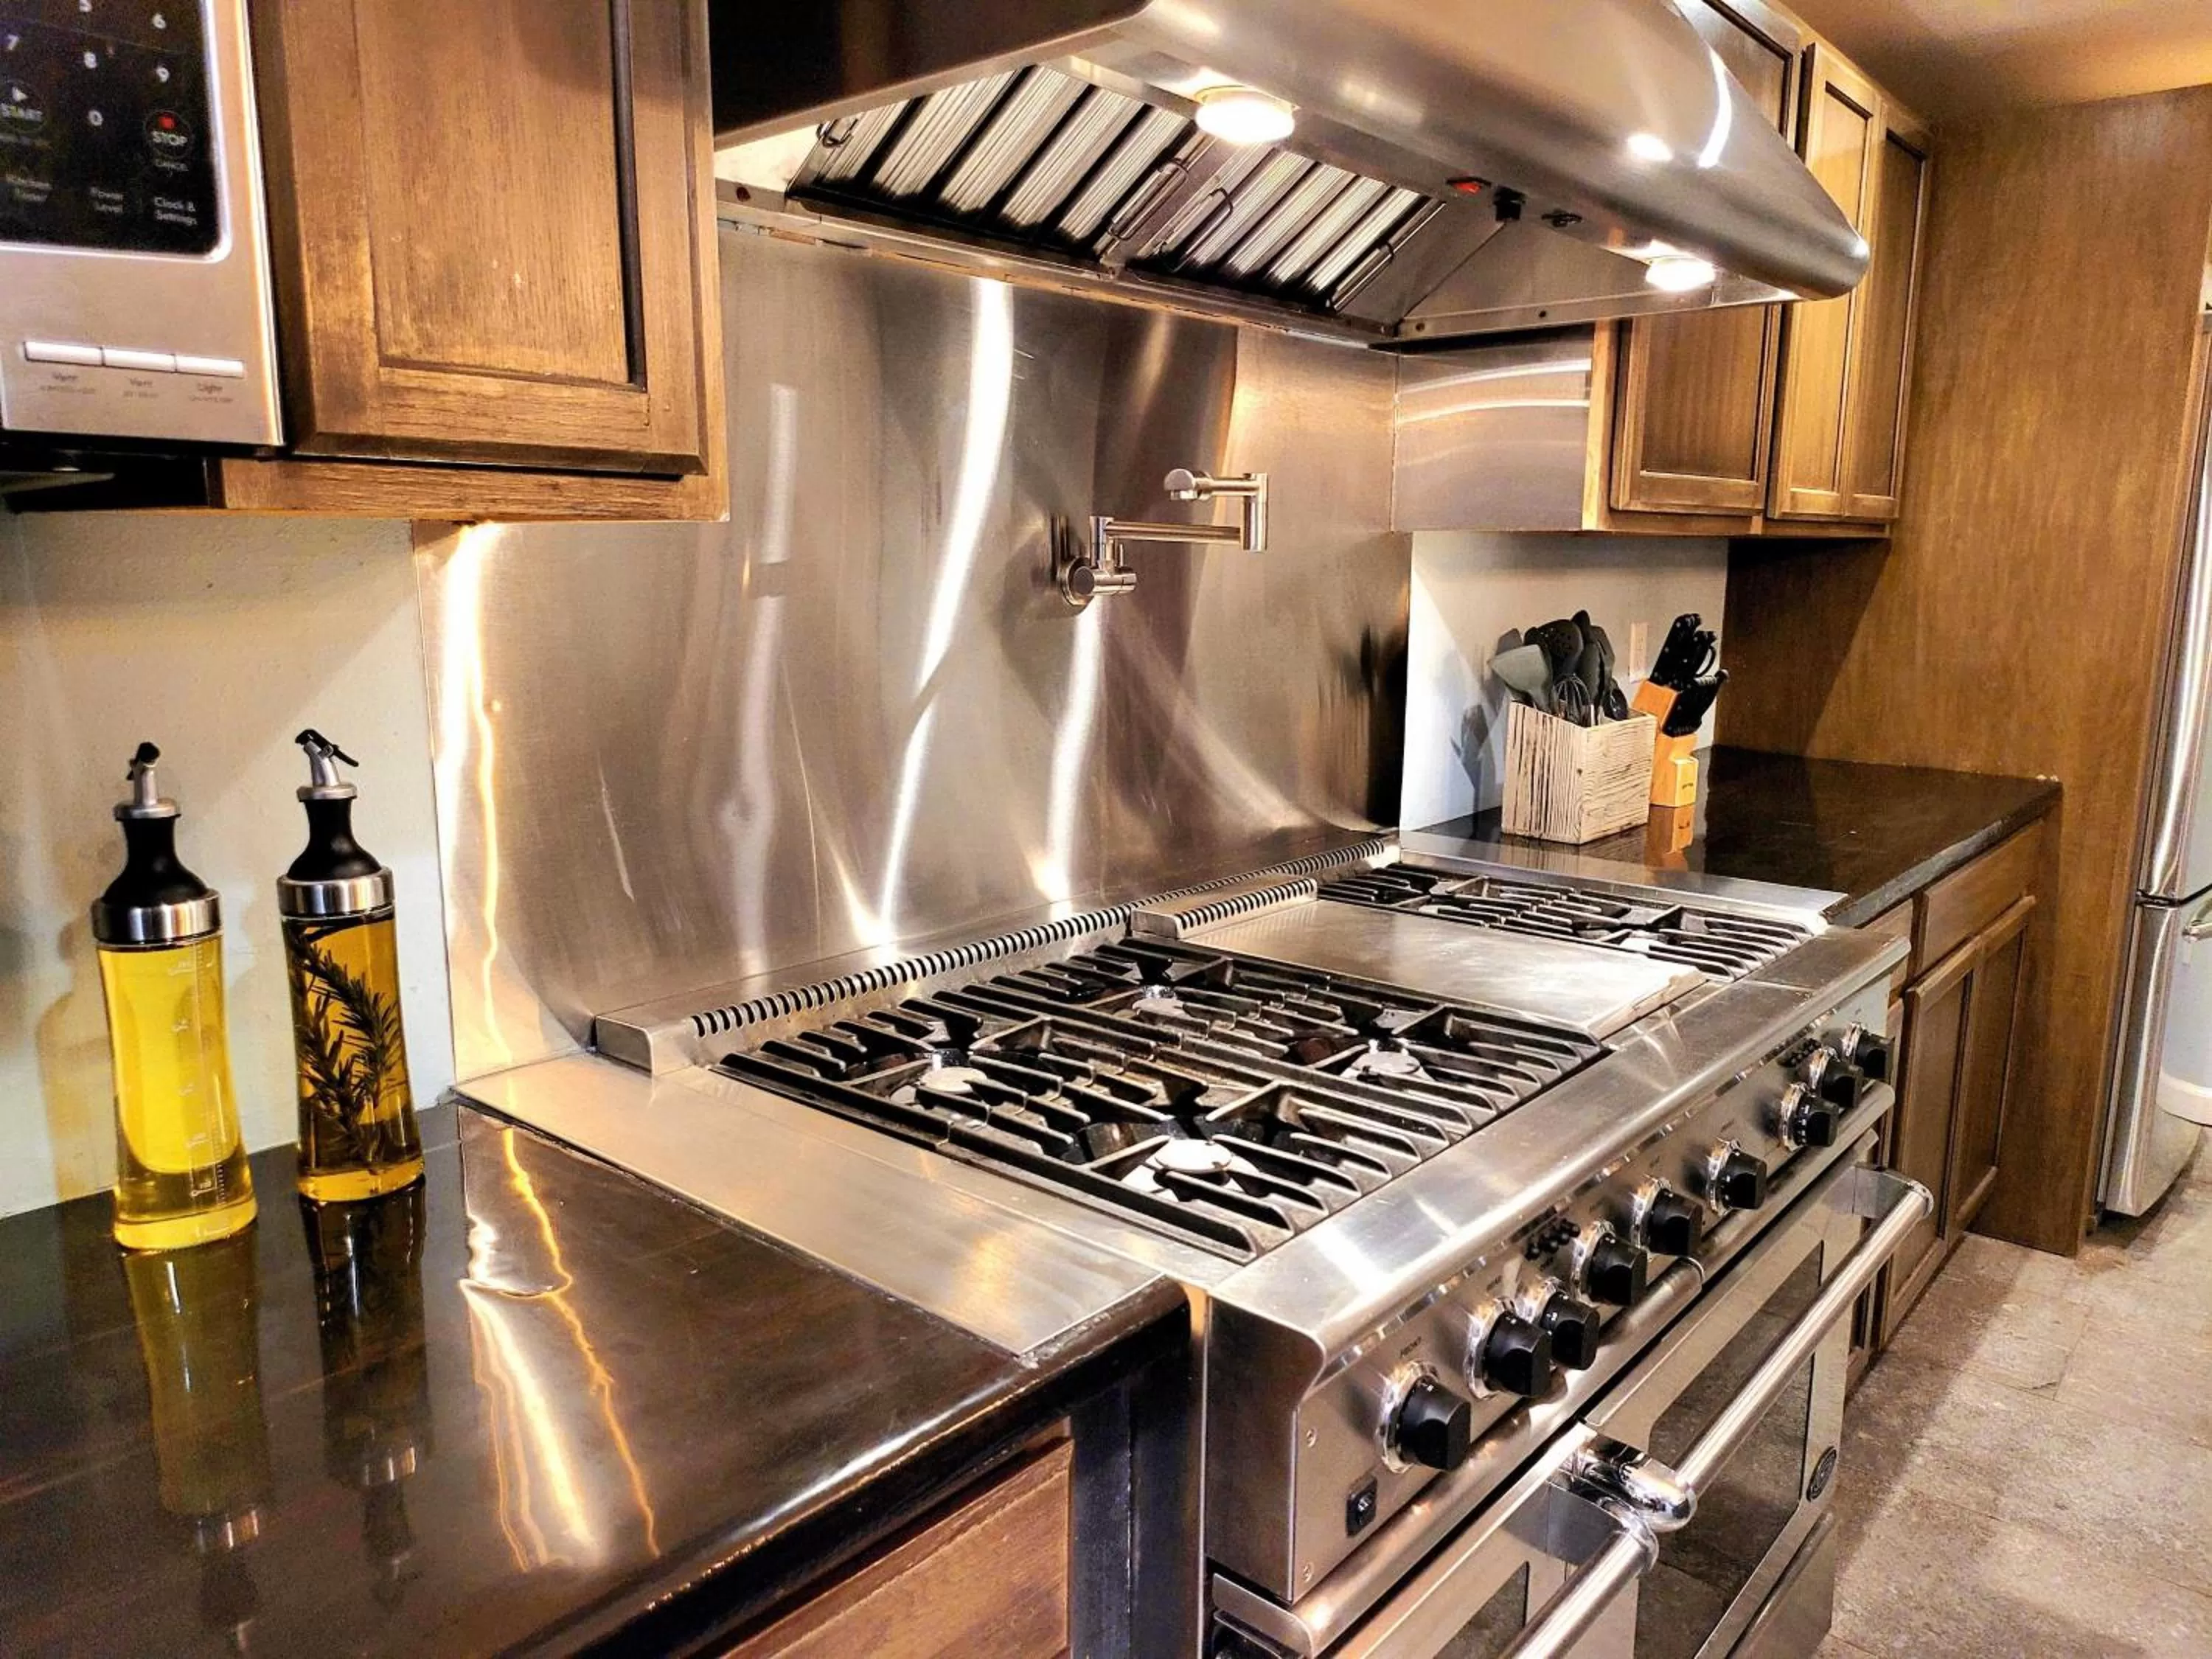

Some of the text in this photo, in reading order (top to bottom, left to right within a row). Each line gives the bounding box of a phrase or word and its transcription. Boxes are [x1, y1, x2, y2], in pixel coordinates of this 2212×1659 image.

[152, 13, 167, 29] 6
[7, 34, 19, 51] 7
[83, 51, 97, 69] 8
[156, 66, 170, 83] 9
[88, 109, 103, 127] 0
[152, 131, 188, 147] STOP
